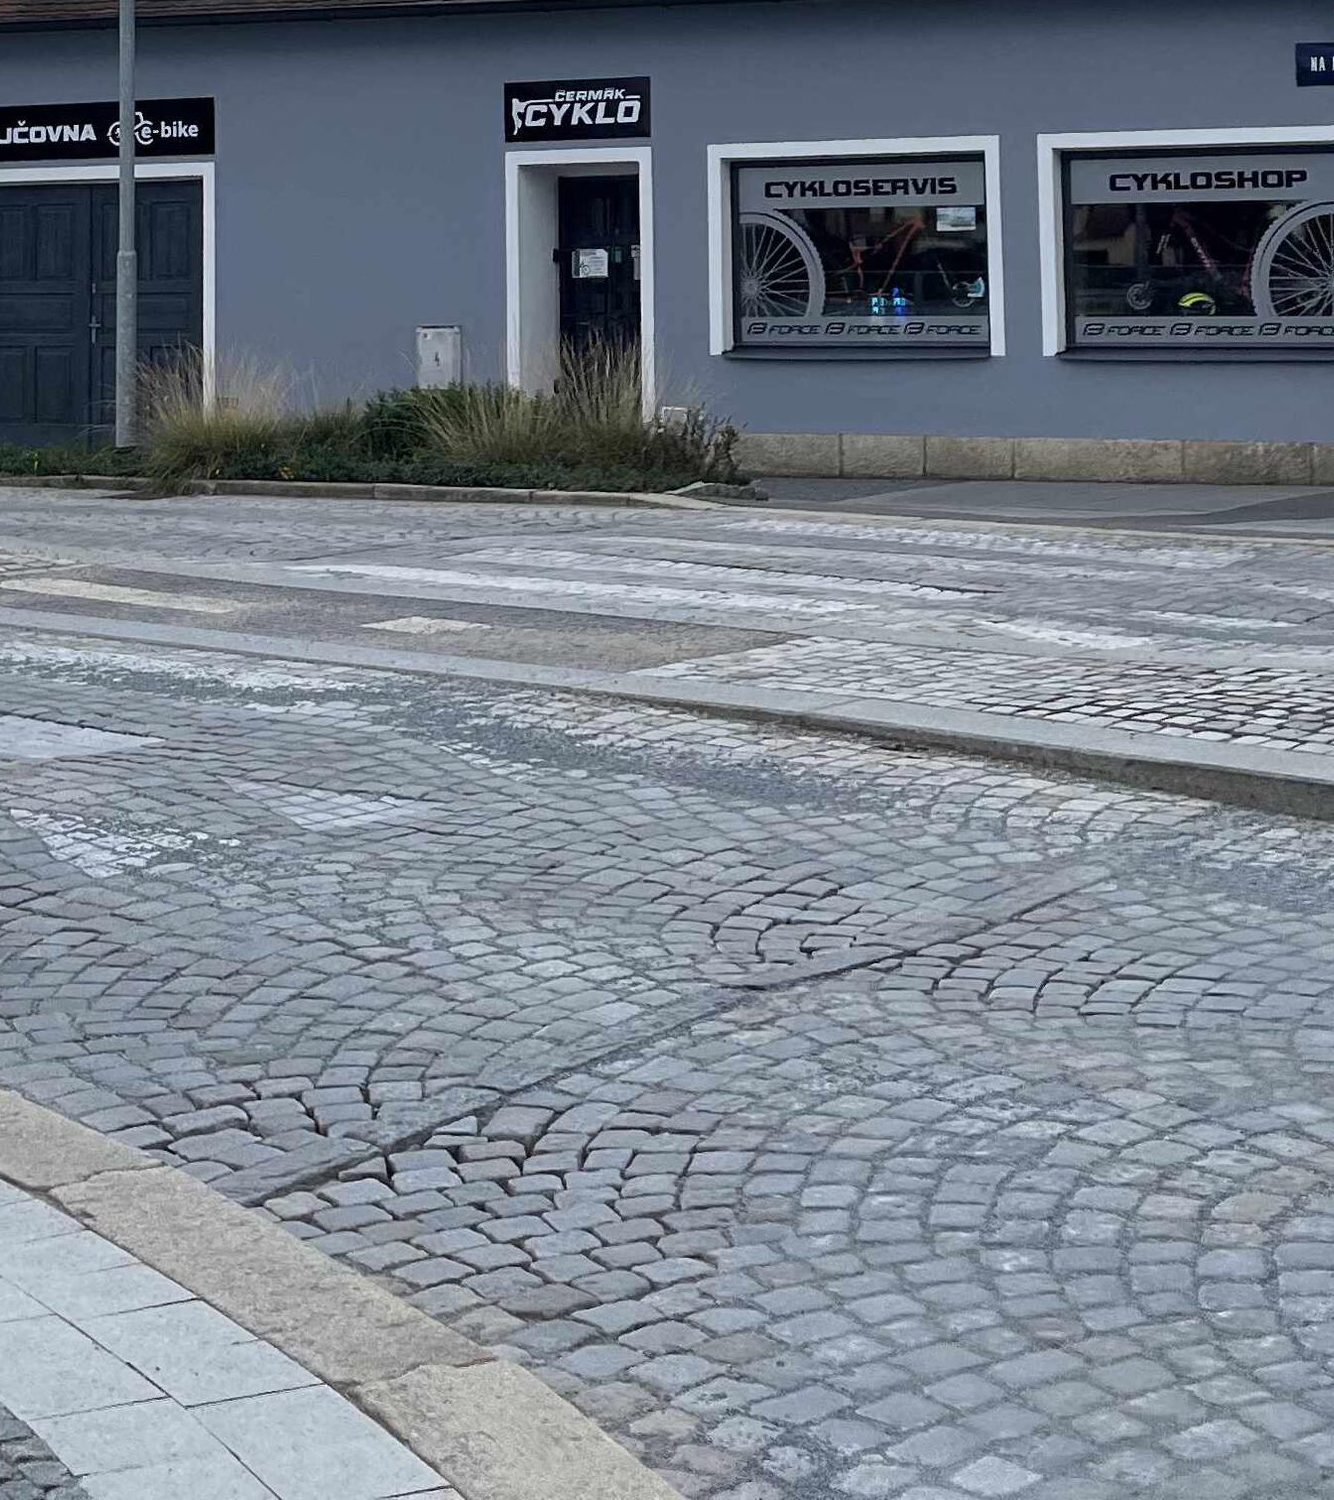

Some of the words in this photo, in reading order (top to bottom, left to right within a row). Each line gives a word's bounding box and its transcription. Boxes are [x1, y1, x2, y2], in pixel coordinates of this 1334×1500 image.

[1310, 56, 1326, 72] NA
[524, 100, 641, 127] CYKLO
[141, 121, 200, 139] e-bike
[764, 177, 958, 199] CYKLOSERVIS
[1109, 169, 1309, 192] CYKLOSHOP
